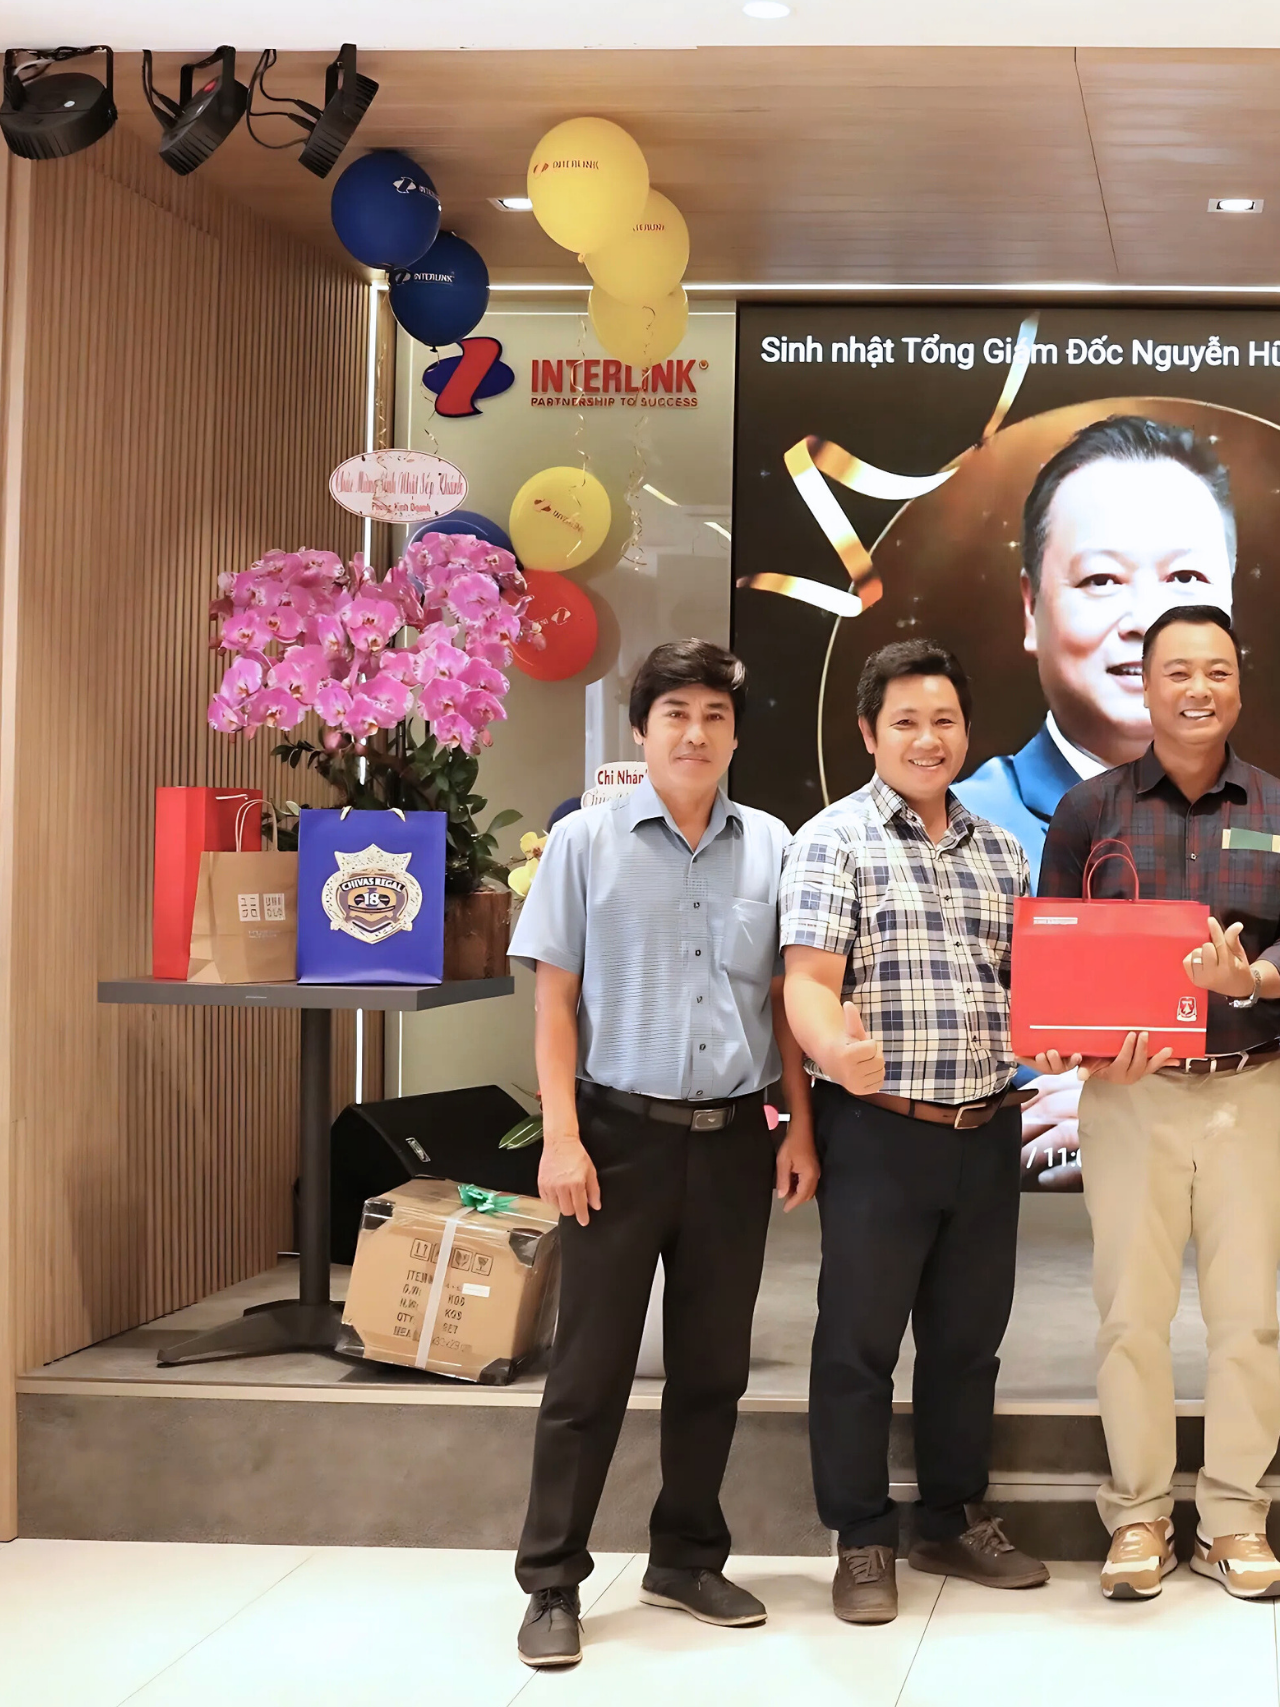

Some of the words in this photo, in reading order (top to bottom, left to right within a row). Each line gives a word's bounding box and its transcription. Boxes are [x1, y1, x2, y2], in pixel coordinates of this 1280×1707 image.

[761, 335, 823, 363] Sinh
[831, 335, 895, 368] nhật
[901, 333, 975, 370] Tổng
[983, 336, 1058, 364] Giám
[1066, 334, 1124, 365] Đốc
[1132, 336, 1240, 372] Nguyễn
[531, 397, 615, 407] PARTNERSHIP
[621, 397, 636, 407] TO
[641, 397, 698, 407] SUCCESS
[597, 769, 613, 785] Chi
[617, 768, 648, 785] Nhán
[341, 877, 374, 891] CHIVAS
[374, 877, 402, 892] REGAL
[363, 892, 380, 905] 18
